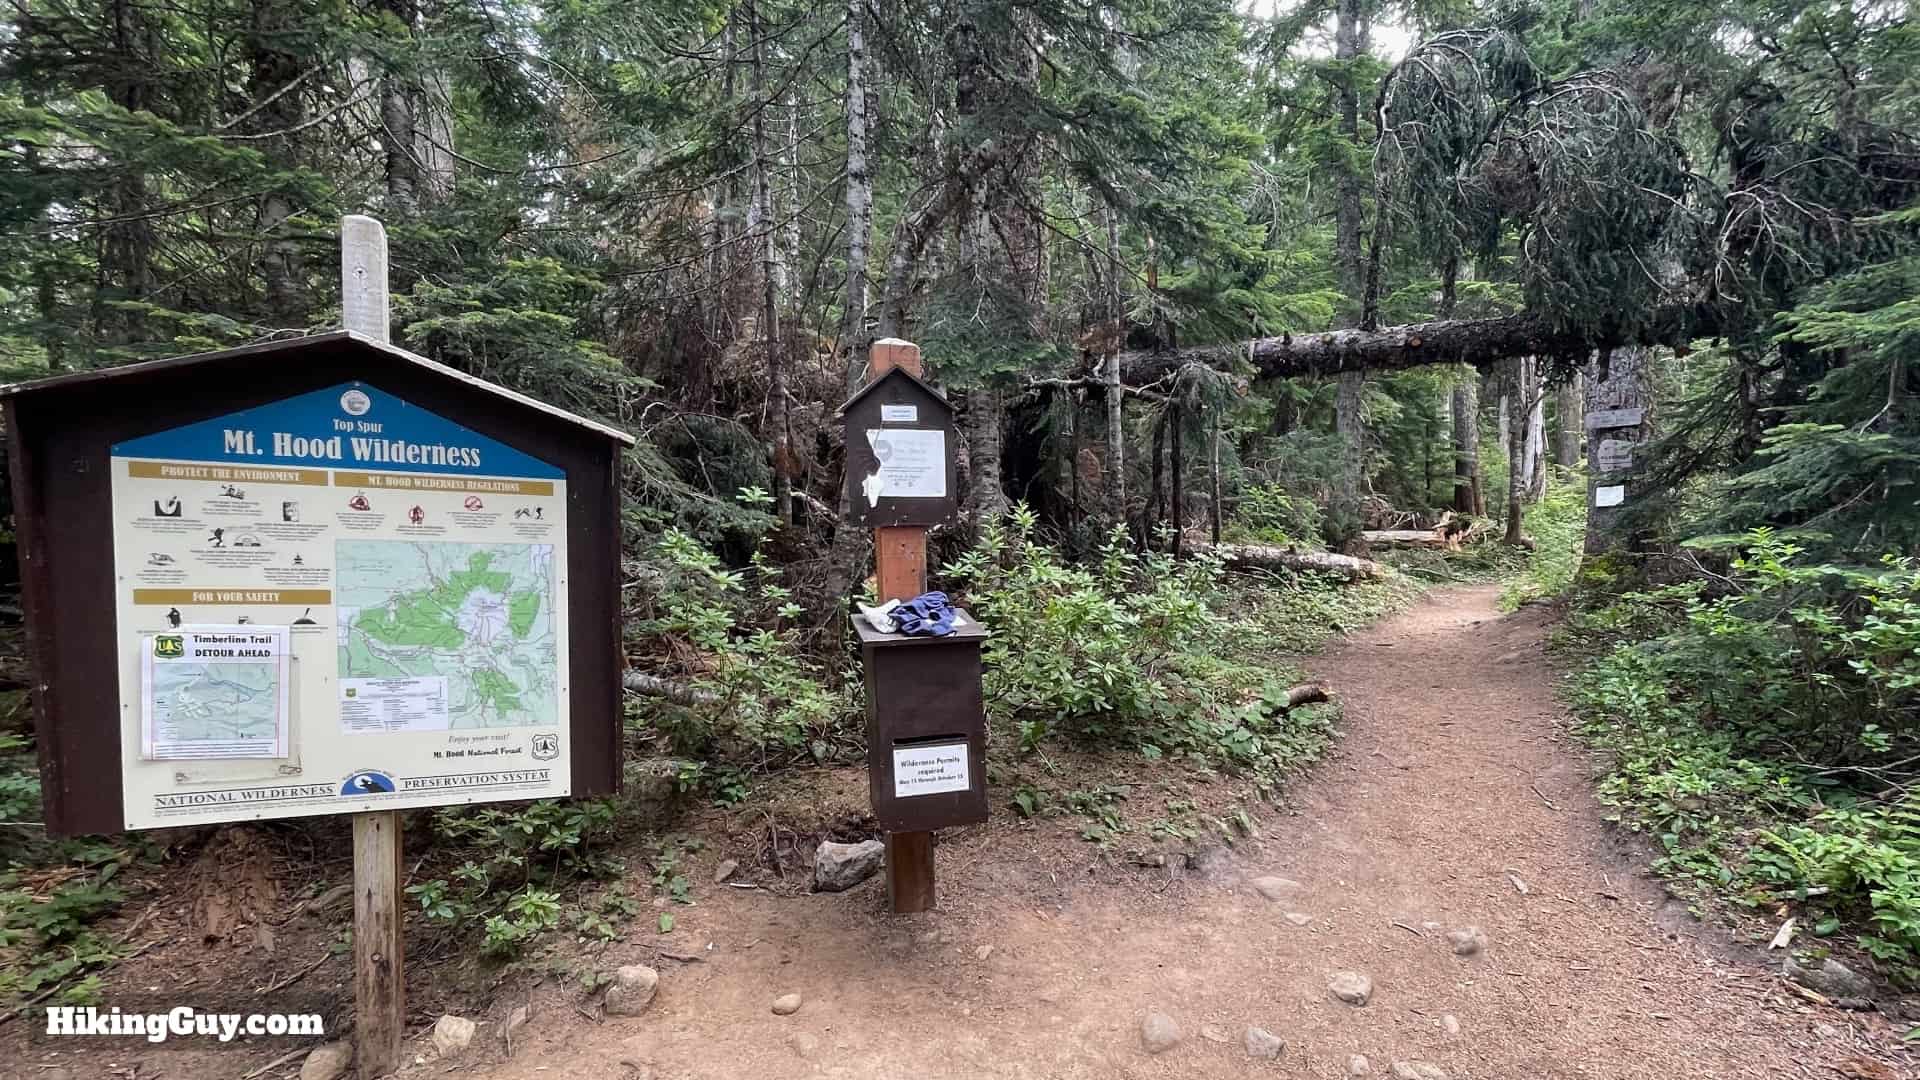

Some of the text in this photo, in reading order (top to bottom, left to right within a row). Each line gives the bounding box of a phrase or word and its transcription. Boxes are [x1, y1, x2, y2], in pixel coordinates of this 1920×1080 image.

[332, 418, 384, 434] Top Spur
[223, 429, 481, 467] Mt. Hood Wilderness
[161, 465, 300, 482] PROTECT THE ENVIRONMENT
[385, 477, 412, 488] HOOD
[414, 478, 465, 490] WILDERNESS
[467, 480, 520, 492] REGULATIONS
[192, 591, 280, 602] FOR YOUR SAFETY
[193, 634, 272, 644] Timberline Trail
[195, 649, 271, 658] DETOUR AHEAD
[467, 748, 499, 757] National
[500, 746, 522, 755] Forest
[901, 757, 960, 768] Wilderness Permits
[918, 767, 944, 776] required
[155, 792, 237, 808] NATIONAL
[240, 785, 335, 801] WILDERNESS
[404, 773, 500, 790] PRESERVATION
[501, 770, 550, 784] SYSTEM
